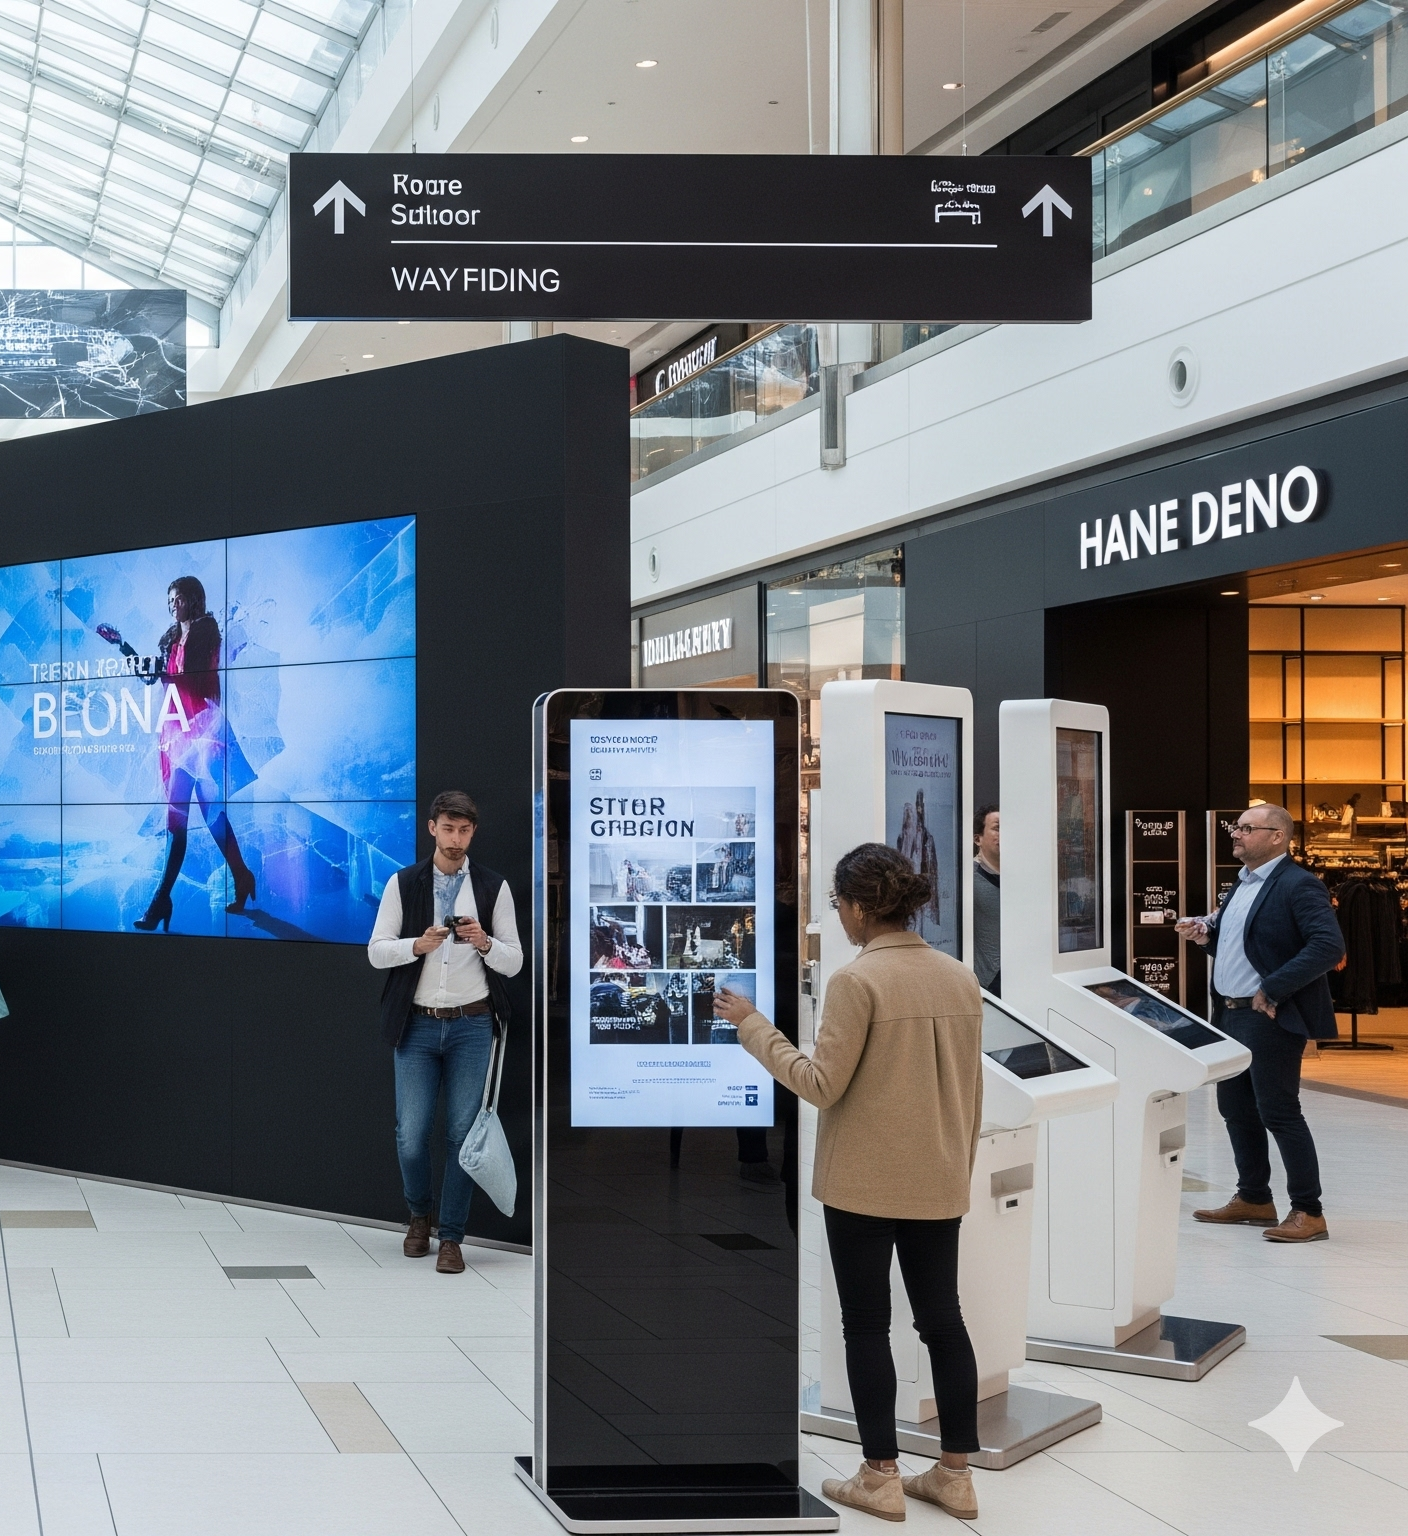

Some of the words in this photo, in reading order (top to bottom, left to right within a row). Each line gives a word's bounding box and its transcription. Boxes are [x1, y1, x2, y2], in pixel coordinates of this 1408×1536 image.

[1080, 498, 1178, 570] HANE
[1192, 465, 1318, 546] DENO
[33, 683, 191, 739] BEONA
